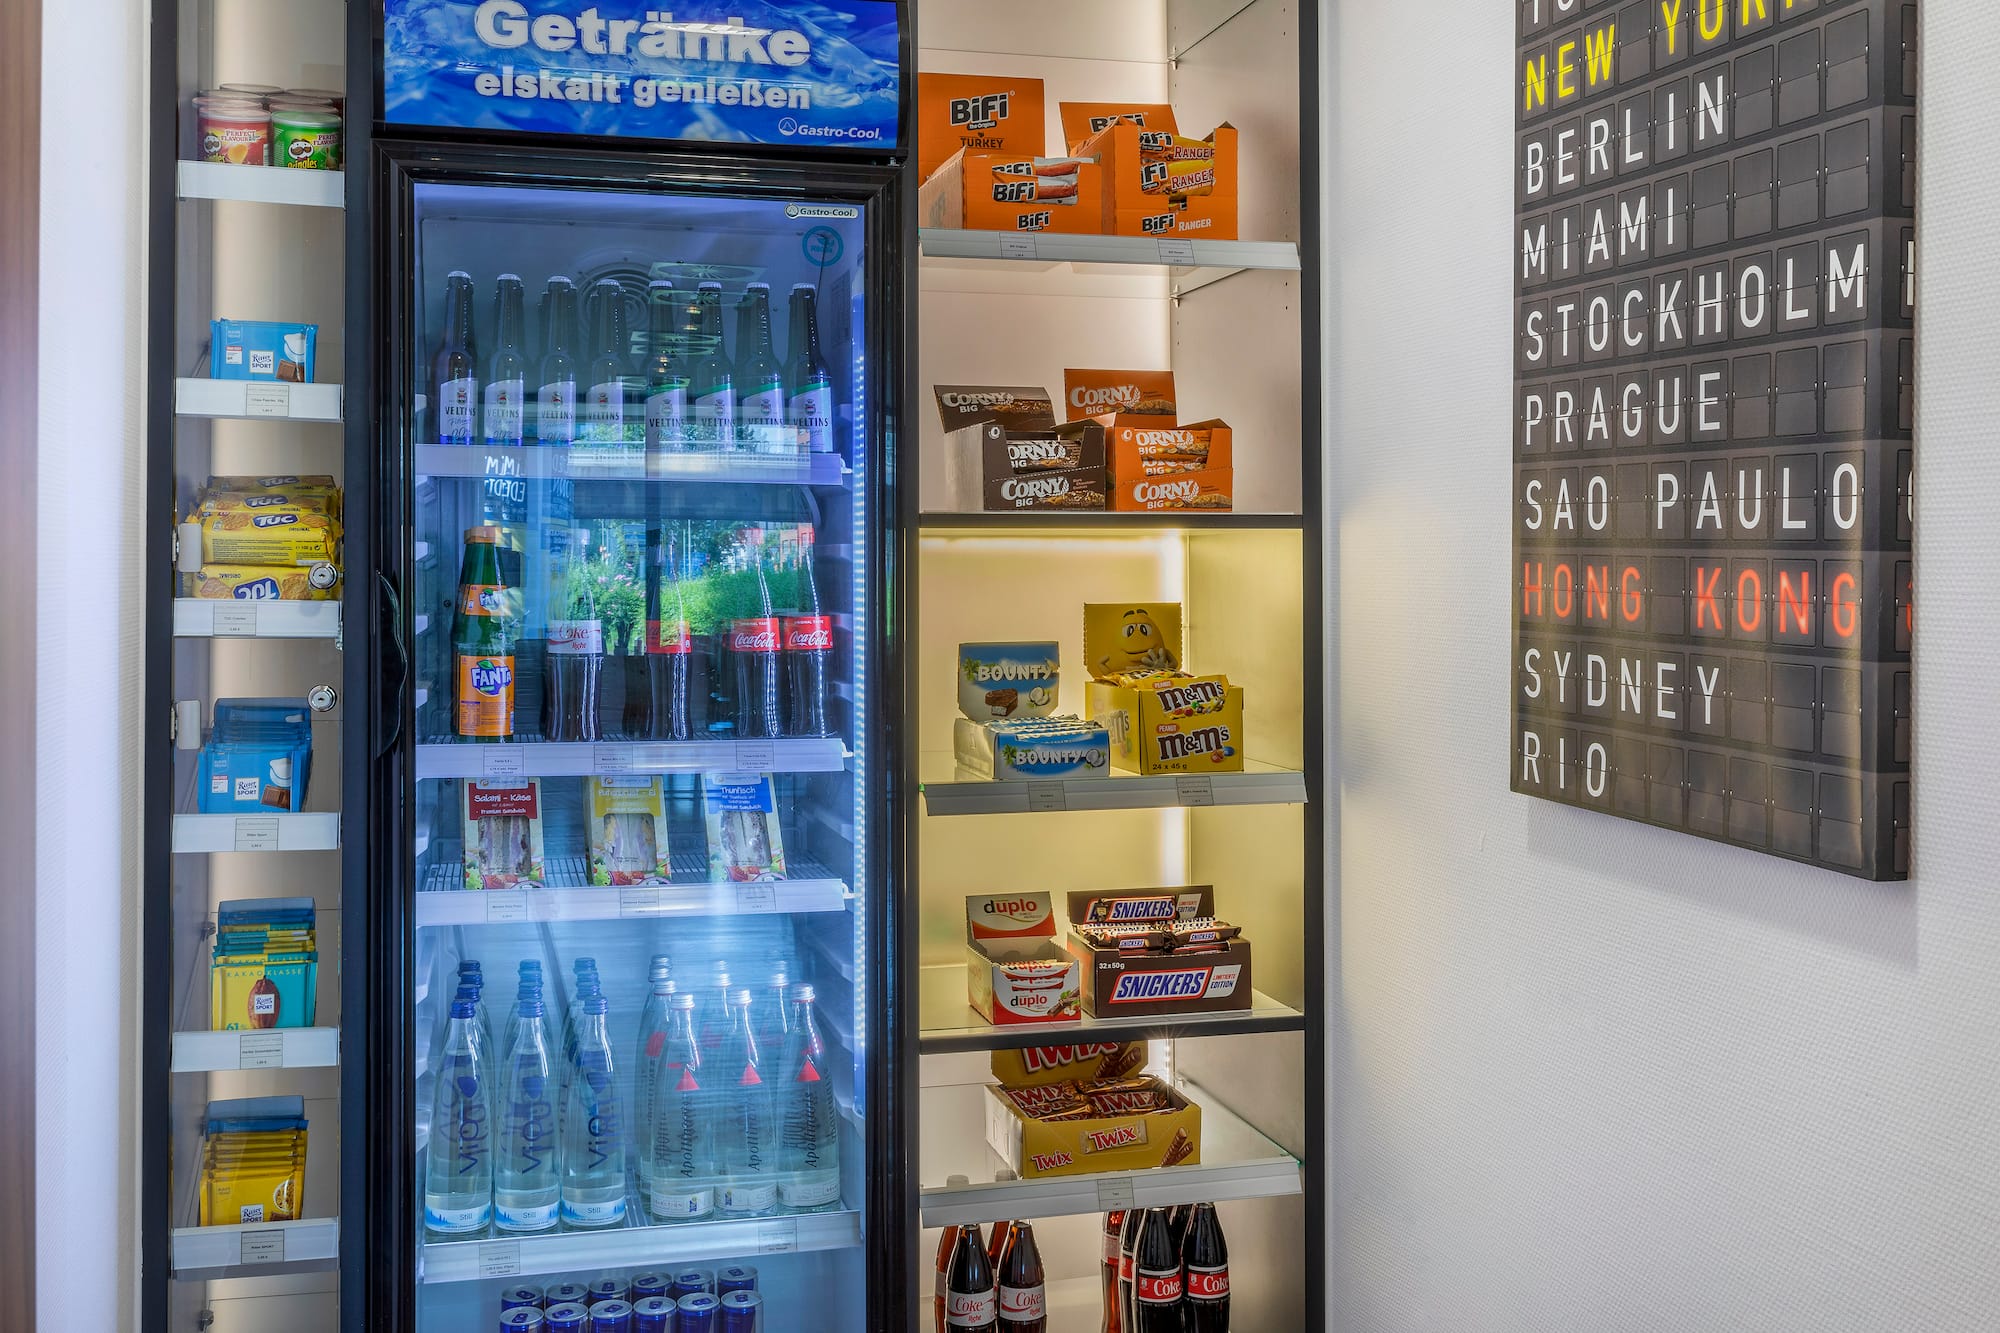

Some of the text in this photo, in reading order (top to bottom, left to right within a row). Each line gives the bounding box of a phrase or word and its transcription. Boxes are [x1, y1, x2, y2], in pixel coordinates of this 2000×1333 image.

[474, 0, 811, 67] Getränke
[1526, 0, 1793, 111] NEW YO
[633, 77, 811, 109] genießen
[950, 92, 1008, 126] BiFi
[798, 125, 880, 139] Gastro-Cool
[1527, 75, 1724, 195] BERLIN
[960, 138, 1004, 148] TURKEY
[993, 182, 1035, 201] BiFi
[800, 208, 853, 217] Gastro-Cool
[1018, 212, 1049, 229] BiFi
[1142, 214, 1212, 232] BiFi RANGER
[1523, 188, 1674, 279] MIAMI
[1526, 243, 1864, 362] STOCKHOLM
[942, 391, 1007, 407] CORNY
[1071, 384, 1134, 407] CORNY
[446, 406, 476, 417] VELTINS
[960, 405, 978, 413] BIG
[1085, 405, 1104, 415] BIG
[1526, 371, 1721, 446] PRAGUE
[793, 417, 829, 427] VELTINS
[1136, 430, 1186, 447] ORNY
[1008, 440, 1058, 460] ORNY
[1138, 446, 1157, 455] BIG
[1146, 467, 1165, 476] BIG
[1001, 476, 1064, 500] CORNY
[1133, 480, 1194, 503] CORNY
[249, 496, 284, 506] TUC
[1016, 497, 1033, 508] BIG
[1147, 500, 1164, 509] BIG
[1525, 463, 1859, 531] SAO PAULO
[256, 515, 294, 526] TUC
[1523, 561, 1857, 639] HONG KONG
[559, 624, 589, 639] Coke
[735, 632, 775, 648] Coca-Cola
[790, 630, 828, 647] Coca-Cola
[471, 666, 511, 687] FANTA
[977, 664, 1050, 681] BOUNTY
[1524, 648, 1720, 725] SYDNEY
[1016, 749, 1080, 765] BOUNTY
[1523, 731, 1607, 798] RIO
[474, 793, 501, 802] Salami
[510, 793, 532, 802] Käse
[721, 786, 756, 794] Thunfisch
[984, 898, 1037, 915] duplo
[1111, 900, 1174, 919] SNICKERS
[1117, 972, 1205, 999] SNICKERS
[1210, 980, 1234, 989] EDITION
[1010, 994, 1048, 1007] duplo
[1089, 1126, 1138, 1150] Twix
[1032, 1150, 1073, 1171] Twix
[459, 1212, 473, 1221] Still
[522, 1211, 537, 1219] Still
[587, 1207, 601, 1215] Still
[1153, 1280, 1180, 1297] Coke
[955, 1297, 983, 1312] Coke
[1015, 1291, 1042, 1307] Coke
